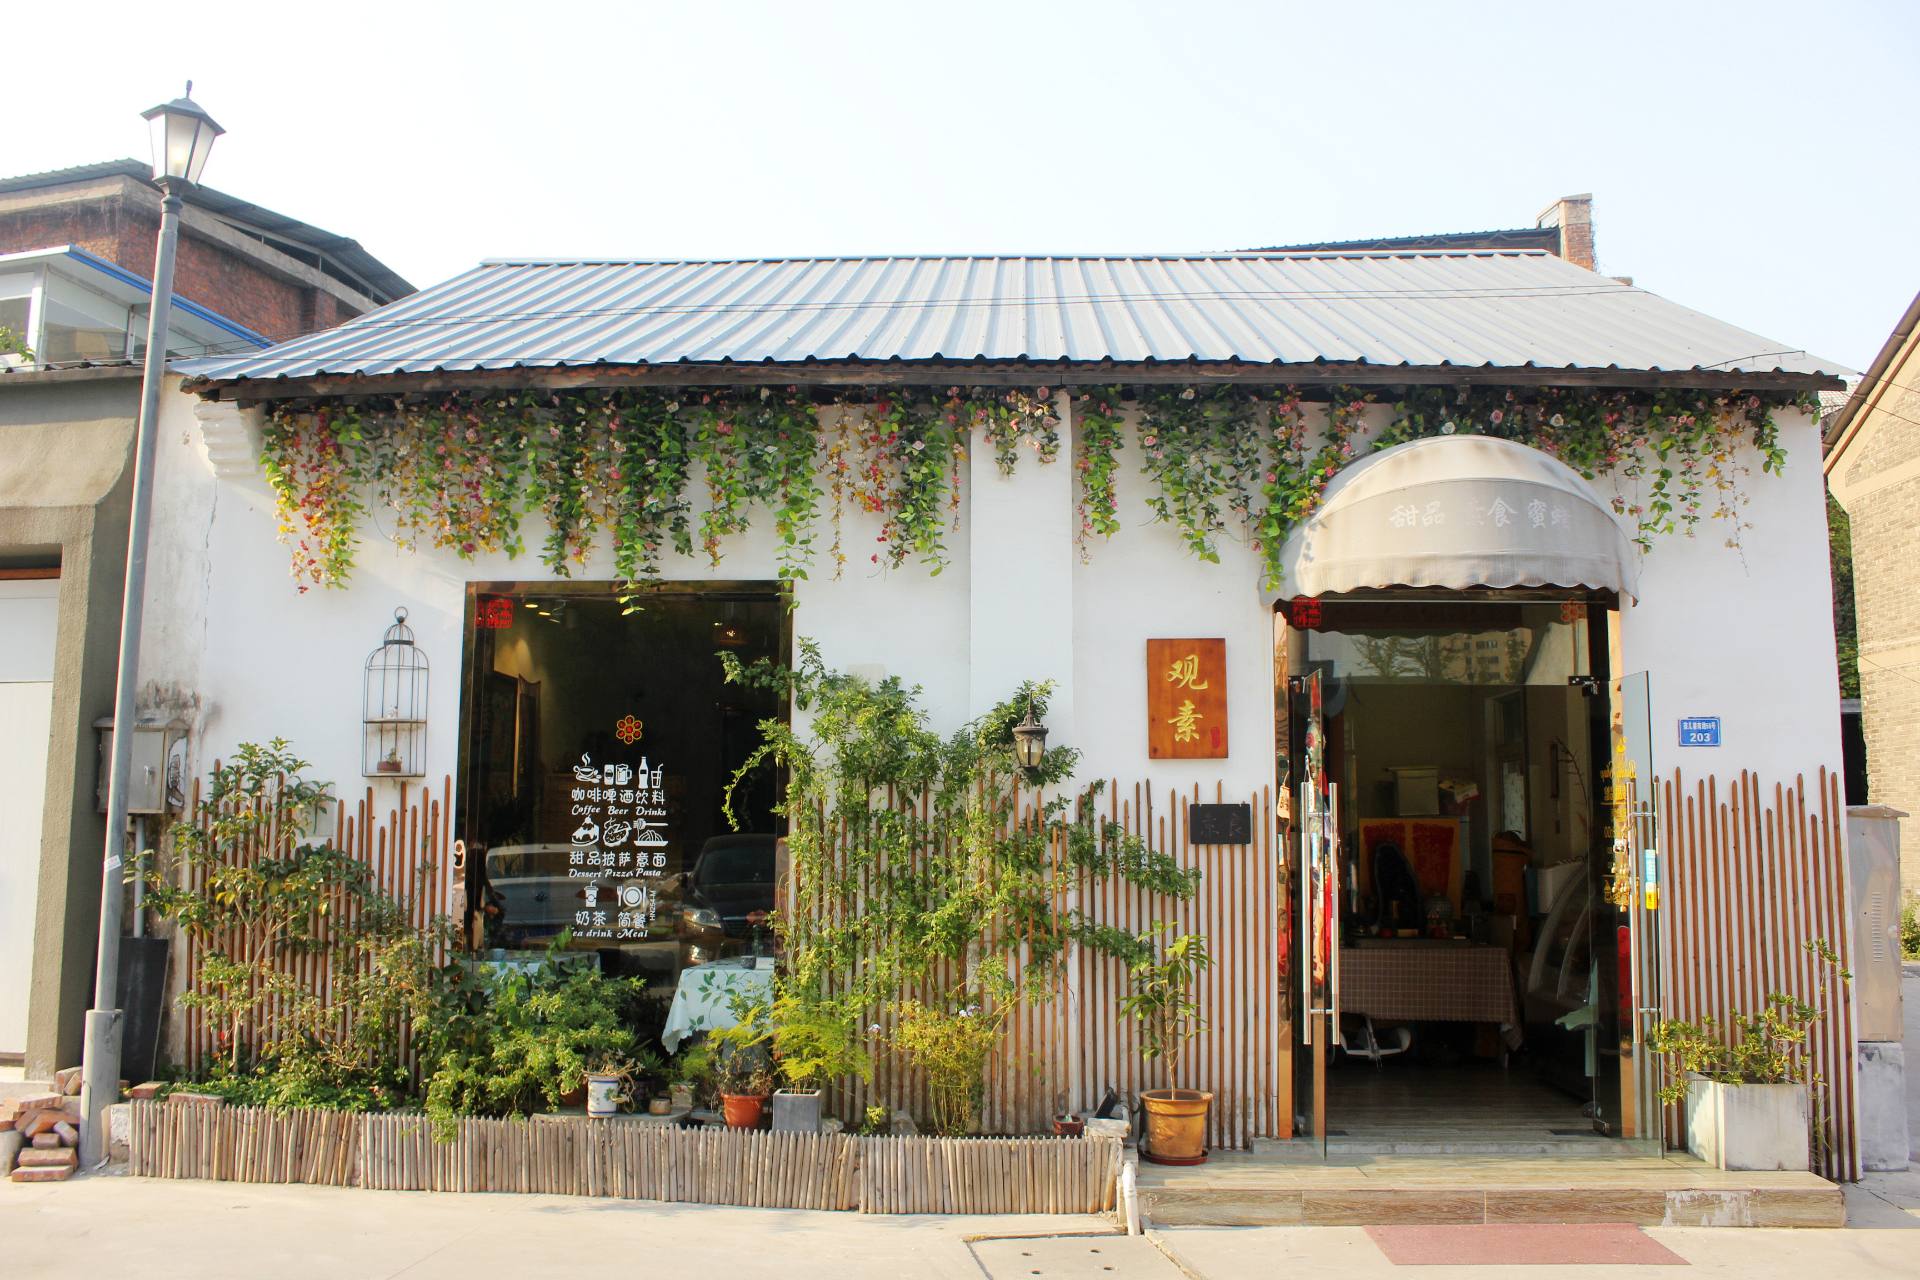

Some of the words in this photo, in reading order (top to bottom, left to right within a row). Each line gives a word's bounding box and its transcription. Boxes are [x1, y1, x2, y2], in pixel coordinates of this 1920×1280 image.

[1389, 500, 1447, 528] 甜品
[1168, 654, 1208, 742] 观素
[1690, 732, 1711, 743] 203
[572, 804, 601, 815] Coffee
[607, 806, 628, 815] Beer
[635, 806, 667, 816] Drinks
[569, 869, 602, 878] Dessert
[635, 868, 662, 878] Pasta
[575, 910, 607, 926] 奶茶
[617, 911, 646, 928] 简餐
[586, 929, 612, 937] drink
[617, 928, 648, 938] Meal
